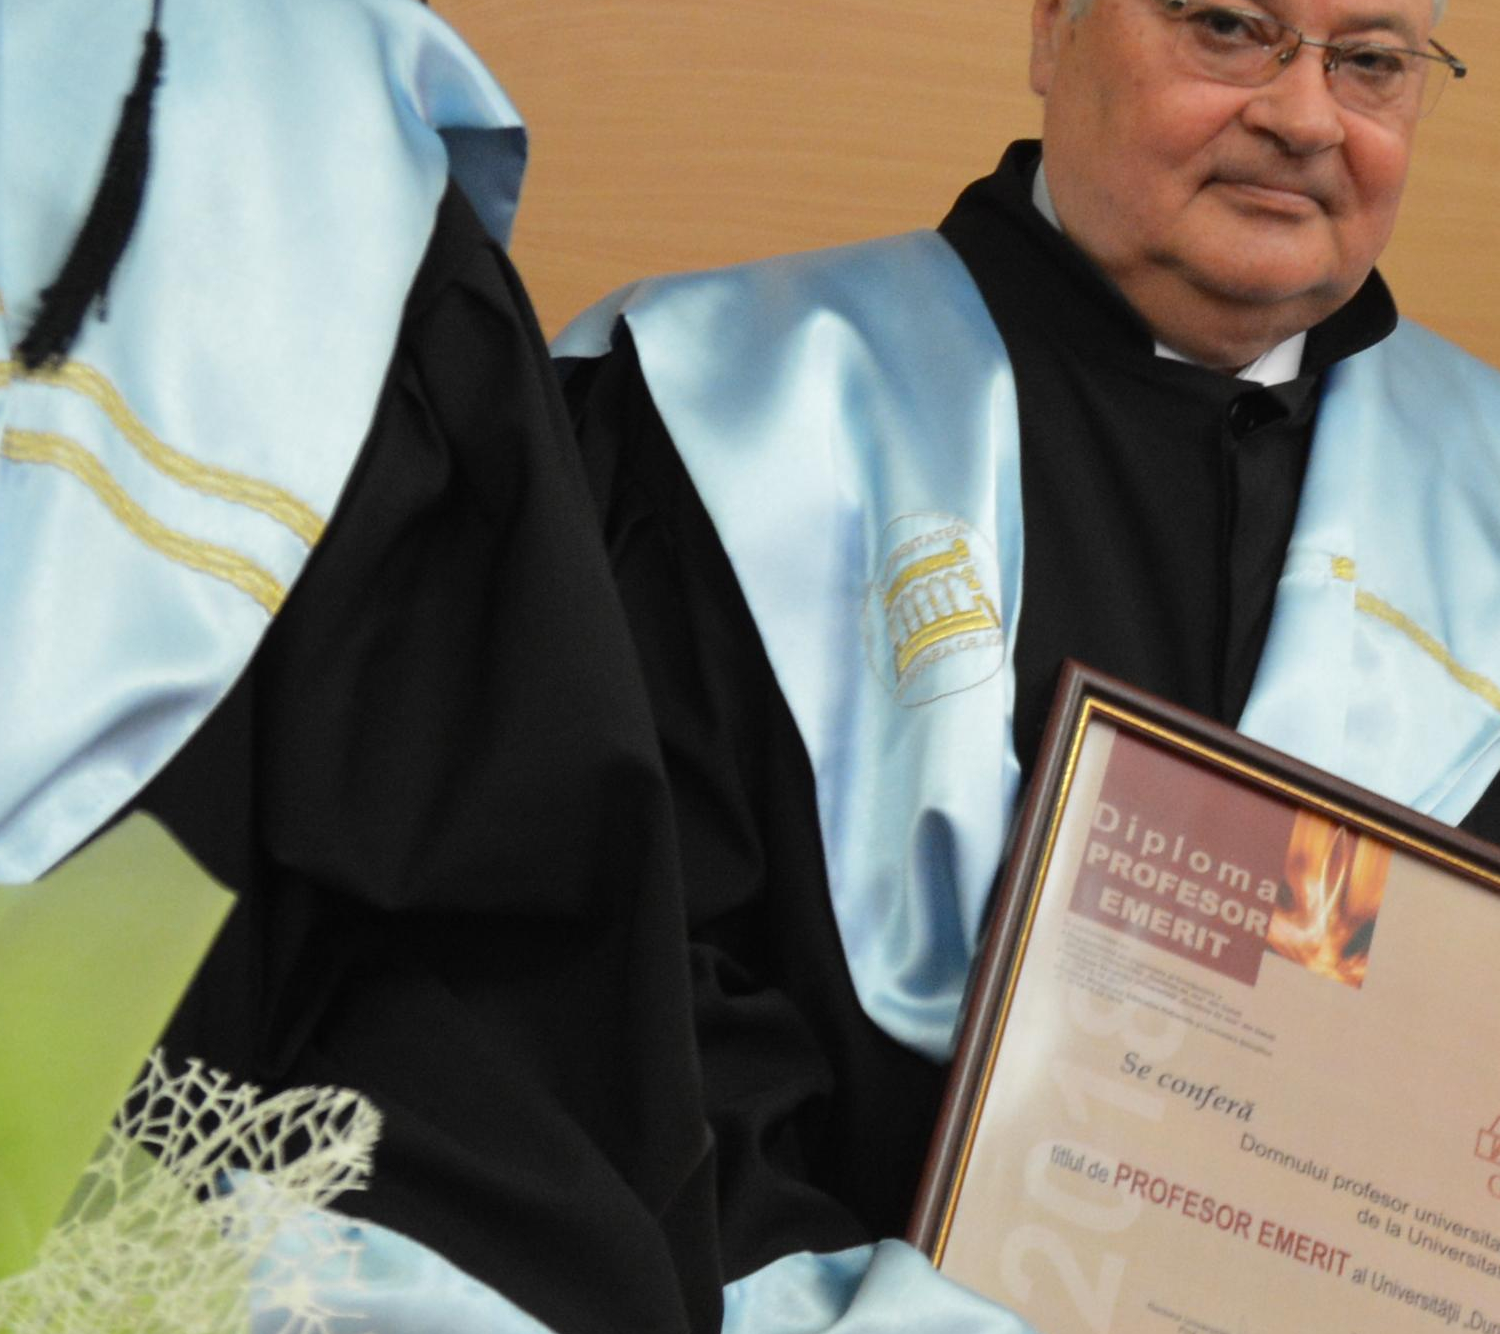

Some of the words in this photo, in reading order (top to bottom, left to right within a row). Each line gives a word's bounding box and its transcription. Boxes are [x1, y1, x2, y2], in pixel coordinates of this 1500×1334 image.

[1086, 840, 1269, 936] PROFESOR
[1091, 801, 1278, 903] Diploma
[1098, 885, 1231, 959] EMERIT
[1120, 1050, 1152, 1081] Se
[1157, 1070, 1257, 1124] conferă
[1050, 1144, 1085, 1172] titlul
[1087, 1160, 1109, 1184] de
[1112, 1161, 1253, 1241] PROFESOR
[1257, 1219, 1352, 1278] EMERIT
[1351, 1266, 1368, 1285] al
[1240, 1132, 1329, 1183] Domnului
[1332, 1170, 1411, 1215] profesor
[1356, 1208, 1381, 1229] de
[1384, 1217, 1403, 1238] la
